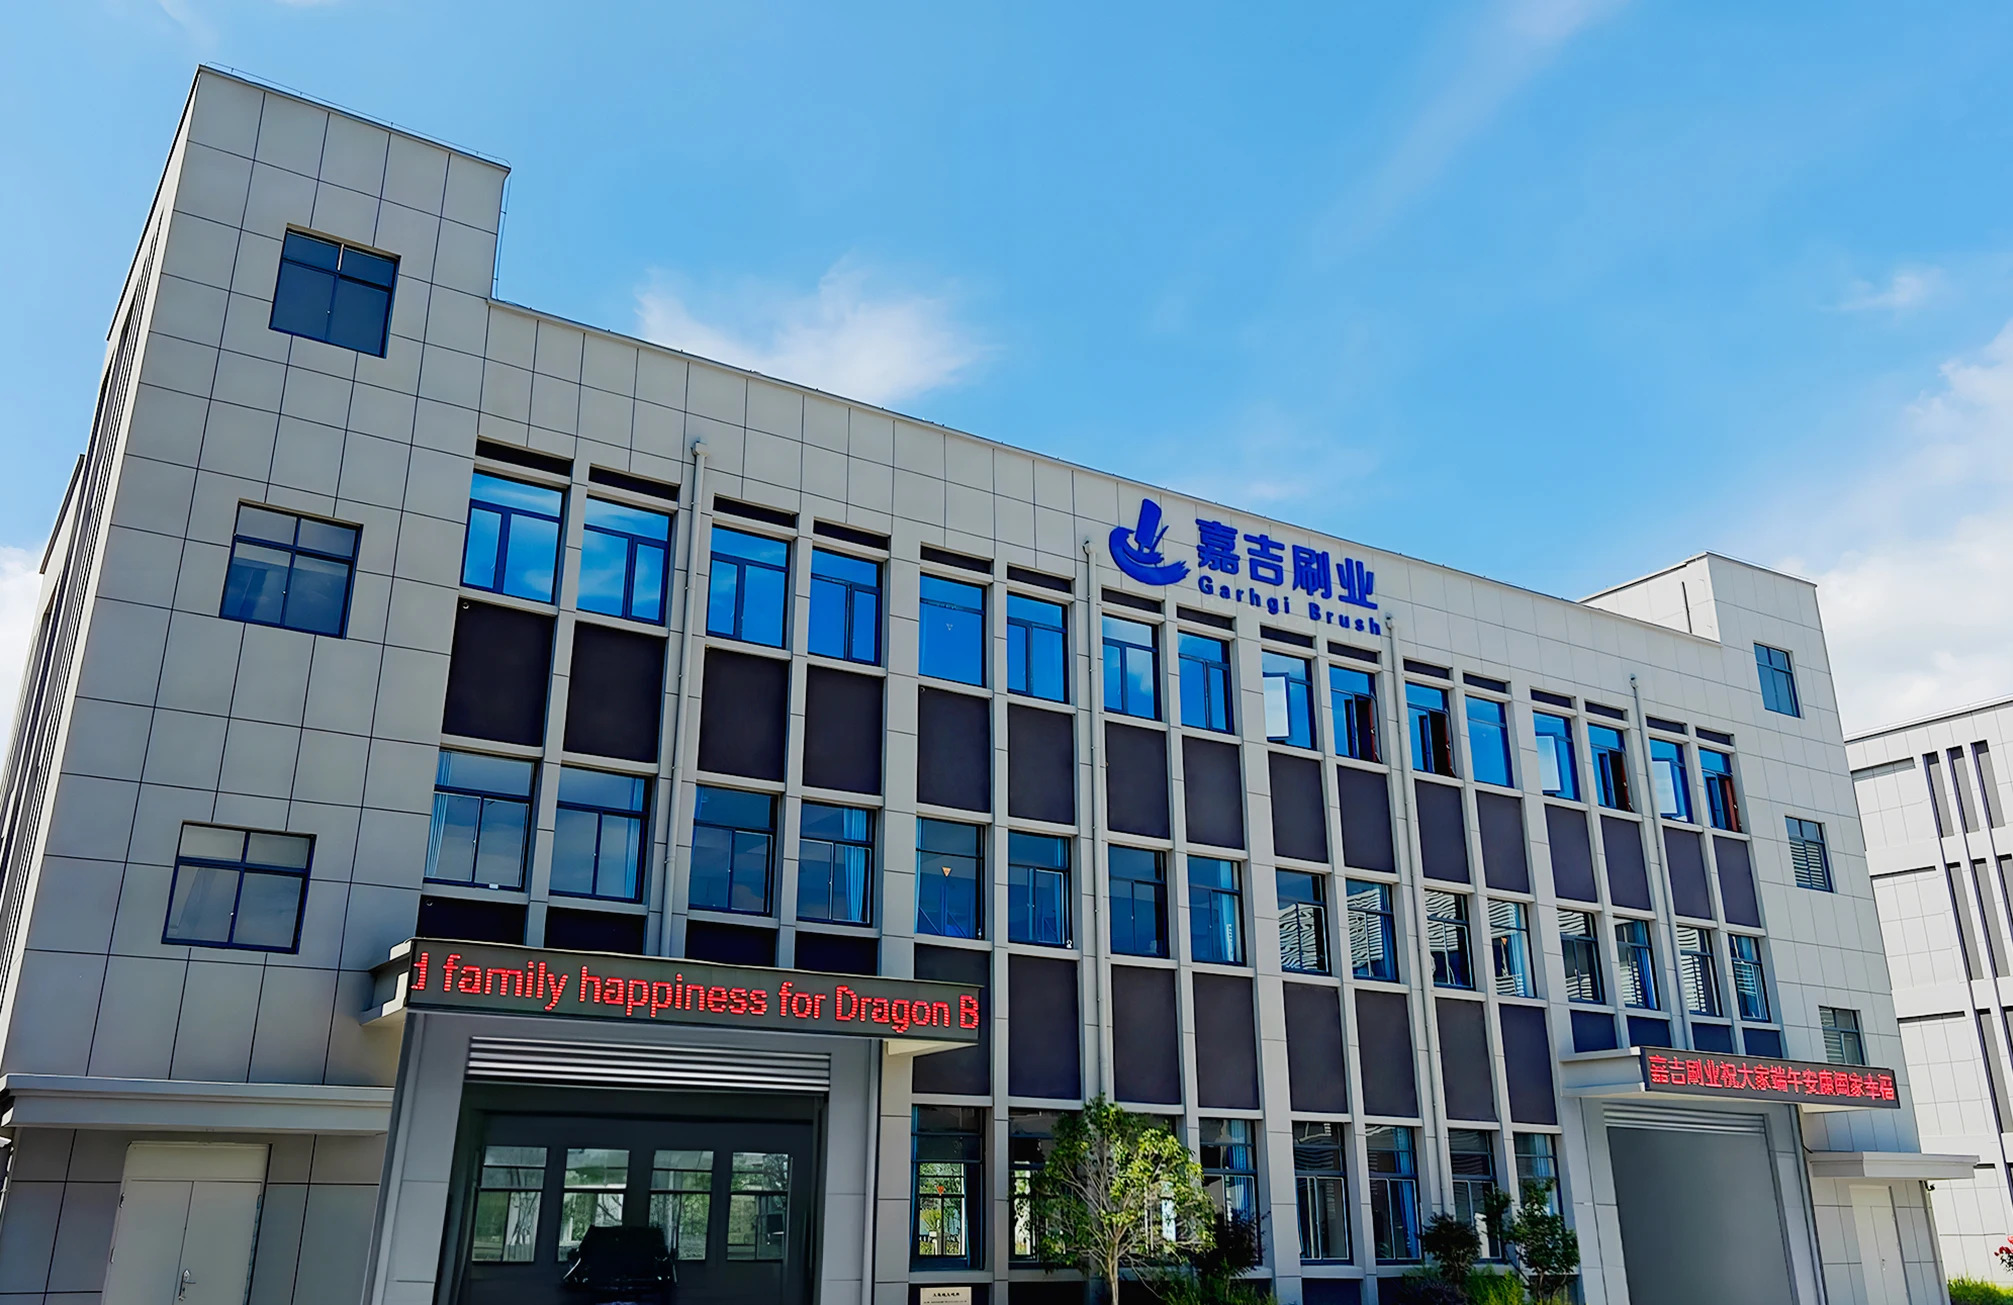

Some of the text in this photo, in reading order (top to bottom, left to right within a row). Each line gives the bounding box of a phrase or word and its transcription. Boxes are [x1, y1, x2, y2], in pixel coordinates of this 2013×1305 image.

[1195, 518, 1379, 610] 嘉吉刷业
[1198, 575, 1381, 636] Garhgi Brush
[442, 953, 569, 1012] family
[579, 966, 768, 1018] happiness
[778, 981, 827, 1019] for
[835, 985, 951, 1033] Dragon
[959, 994, 980, 1029] B
